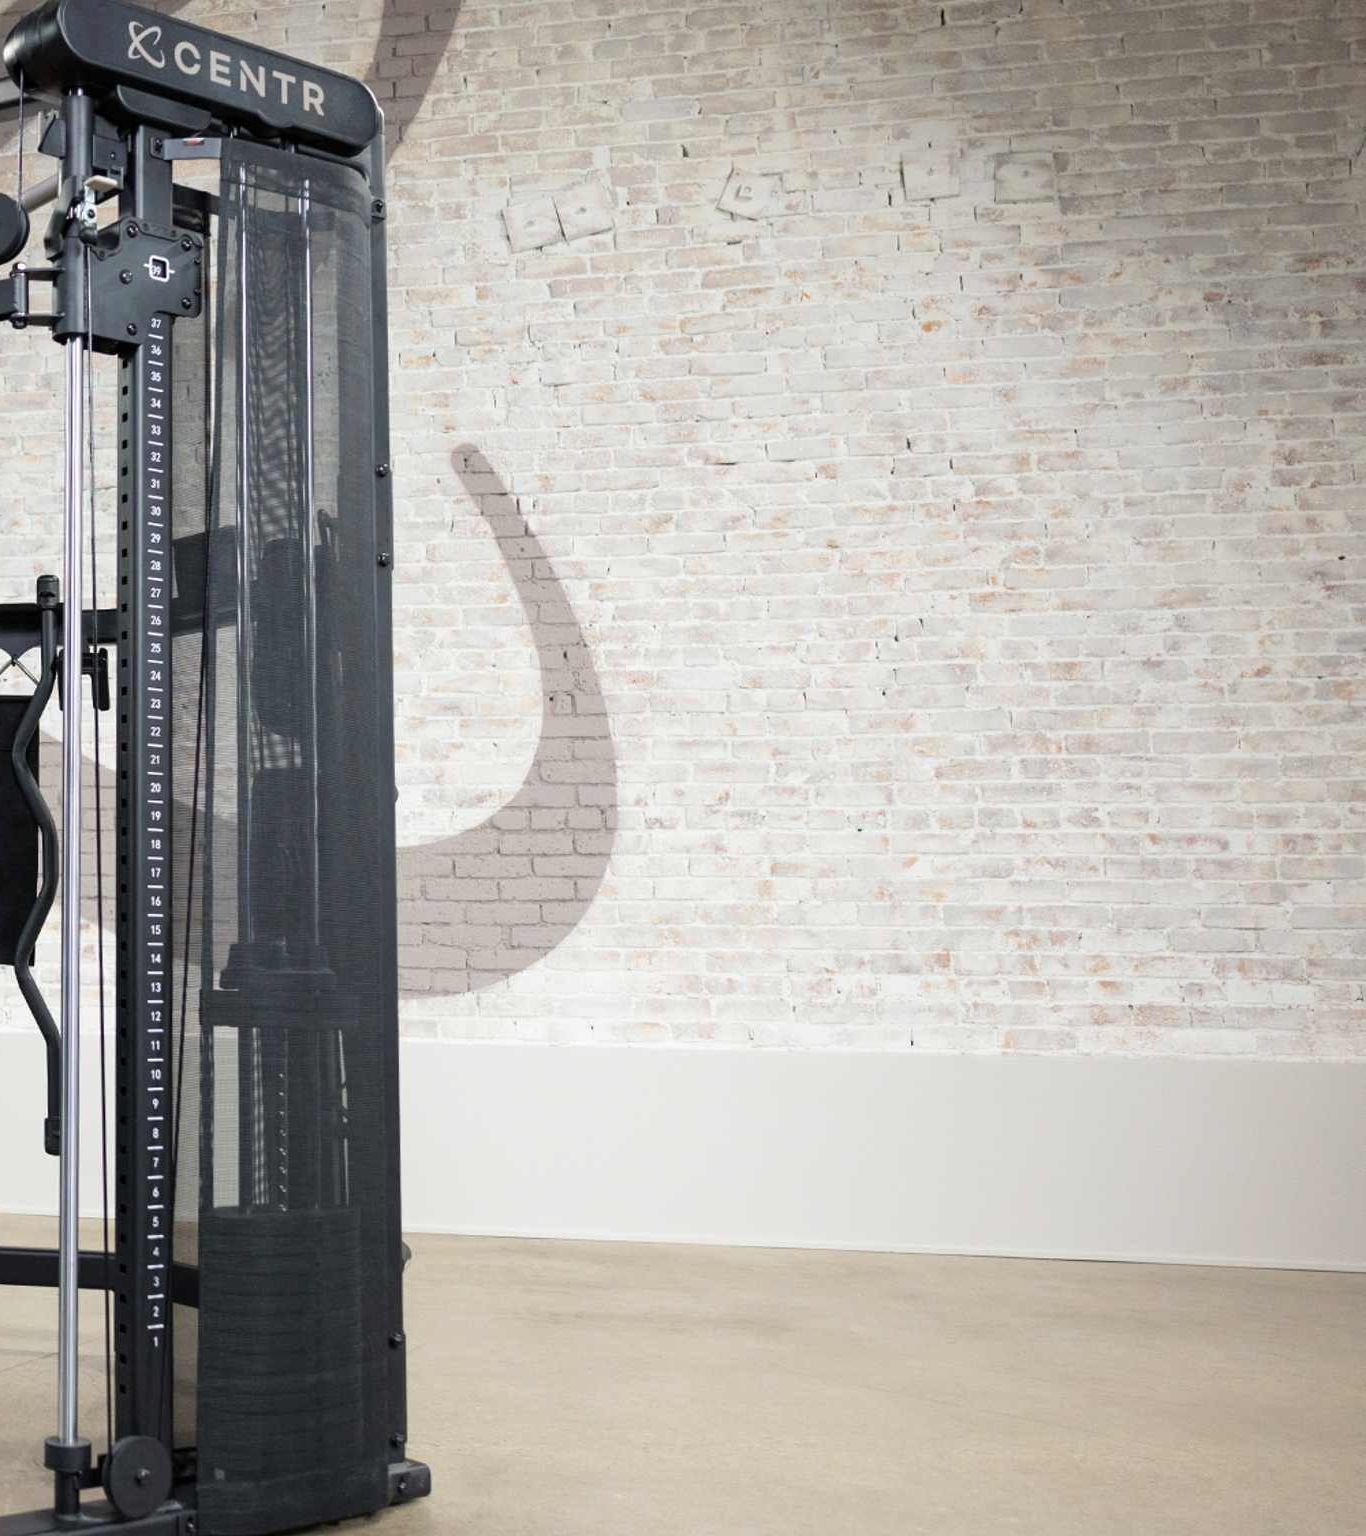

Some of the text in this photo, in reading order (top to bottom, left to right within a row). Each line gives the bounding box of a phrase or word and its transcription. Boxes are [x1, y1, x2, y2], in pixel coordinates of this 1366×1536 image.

[174, 41, 325, 116] CENTR
[151, 317, 162, 329] 37
[150, 344, 162, 356] 36
[150, 370, 162, 382] 35
[150, 397, 162, 409] 34
[150, 424, 162, 436] 33
[150, 451, 162, 463] 32
[150, 478, 160, 489] 31
[150, 505, 162, 517] 30
[150, 532, 162, 544] 29
[150, 559, 162, 571] 28
[150, 587, 162, 598] 27
[150, 614, 162, 626] 26
[150, 642, 162, 654] 25
[150, 670, 161, 681] 24
[150, 697, 162, 709] 23
[150, 726, 161, 737] 22
[150, 753, 160, 765] 21
[150, 782, 162, 793] 20
[150, 810, 162, 821] 19
[150, 839, 162, 850] 18
[150, 867, 162, 878] 17
[150, 895, 162, 907] 16
[150, 924, 162, 936] 15
[150, 953, 162, 964] 14
[150, 981, 162, 993] 13
[150, 1010, 162, 1022] 12
[150, 1039, 161, 1051] 11
[150, 1068, 162, 1080] 10
[152, 1097, 160, 1110] 9
[152, 1127, 160, 1139] 8
[152, 1156, 160, 1168] 7
[152, 1186, 160, 1198] 6
[152, 1215, 160, 1228] 5
[152, 1246, 160, 1257] 4
[153, 1275, 160, 1288] 3
[152, 1305, 160, 1318] 2
[153, 1336, 159, 1348] 1
